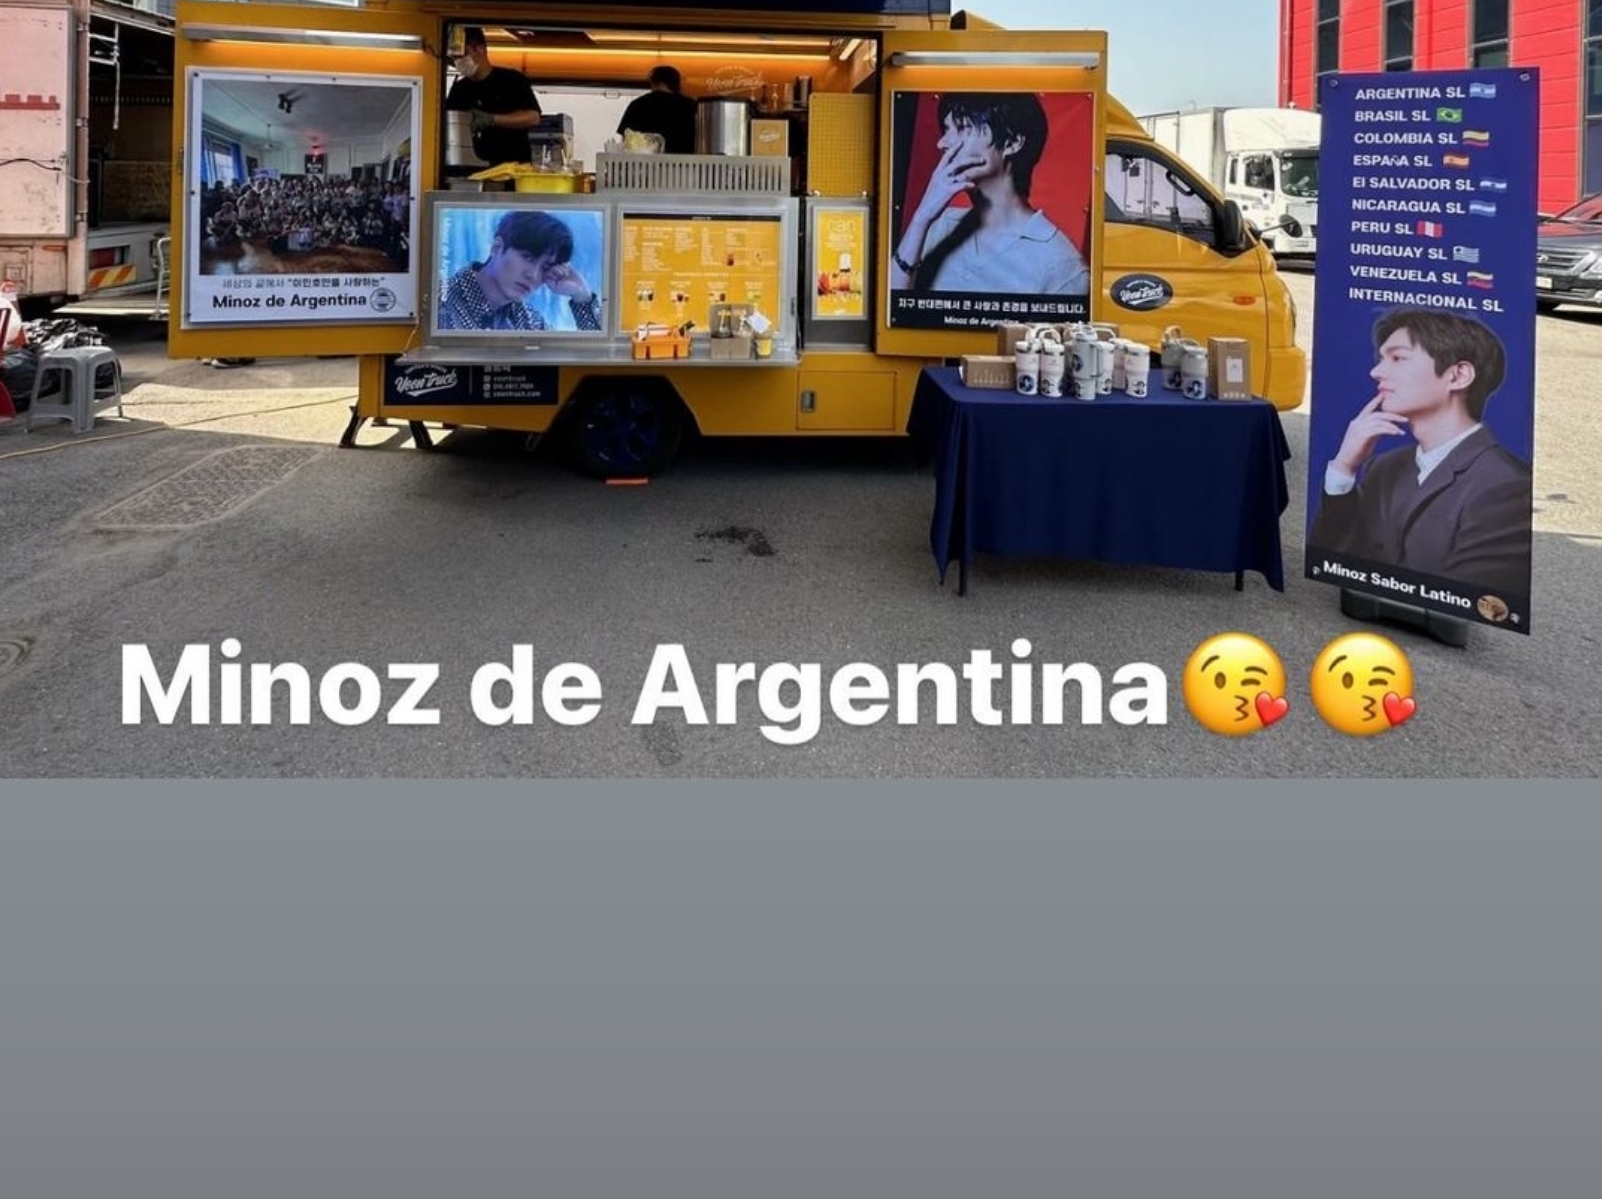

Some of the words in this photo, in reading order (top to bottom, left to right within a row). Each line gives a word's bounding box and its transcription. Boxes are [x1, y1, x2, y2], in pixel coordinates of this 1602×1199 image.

[1355, 88, 1441, 100] ARGENTINA
[1446, 86, 1466, 98] SL
[1354, 110, 1407, 122] BRASIL
[1412, 110, 1431, 121] SL
[1354, 132, 1434, 144] COLOMBIA
[1438, 133, 1458, 144] SL
[1353, 155, 1410, 166] ESPAÑA
[1413, 155, 1433, 167] SL
[1369, 177, 1451, 190] SALVADOR
[1455, 179, 1475, 191] SL
[1351, 199, 1441, 214] NICARAGUA
[1445, 202, 1466, 214] SL
[1351, 221, 1391, 233] PERU
[1395, 223, 1414, 235] SL
[1350, 243, 1423, 258] URUGUAY
[1428, 248, 1448, 260] SL
[1350, 266, 1438, 283] VENEZUELA
[1442, 272, 1462, 285] SL
[212, 294, 260, 309] Minoz
[265, 293, 286, 308] de
[290, 292, 367, 311] Argentina
[1349, 288, 1478, 310] INTERNACIONAL
[1482, 299, 1504, 312] SL
[944, 316, 968, 325] Minoz
[968, 316, 979, 325] de
[1323, 560, 1367, 583] Minoz
[1371, 572, 1416, 594] Sabor
[1420, 584, 1472, 608] Latino
